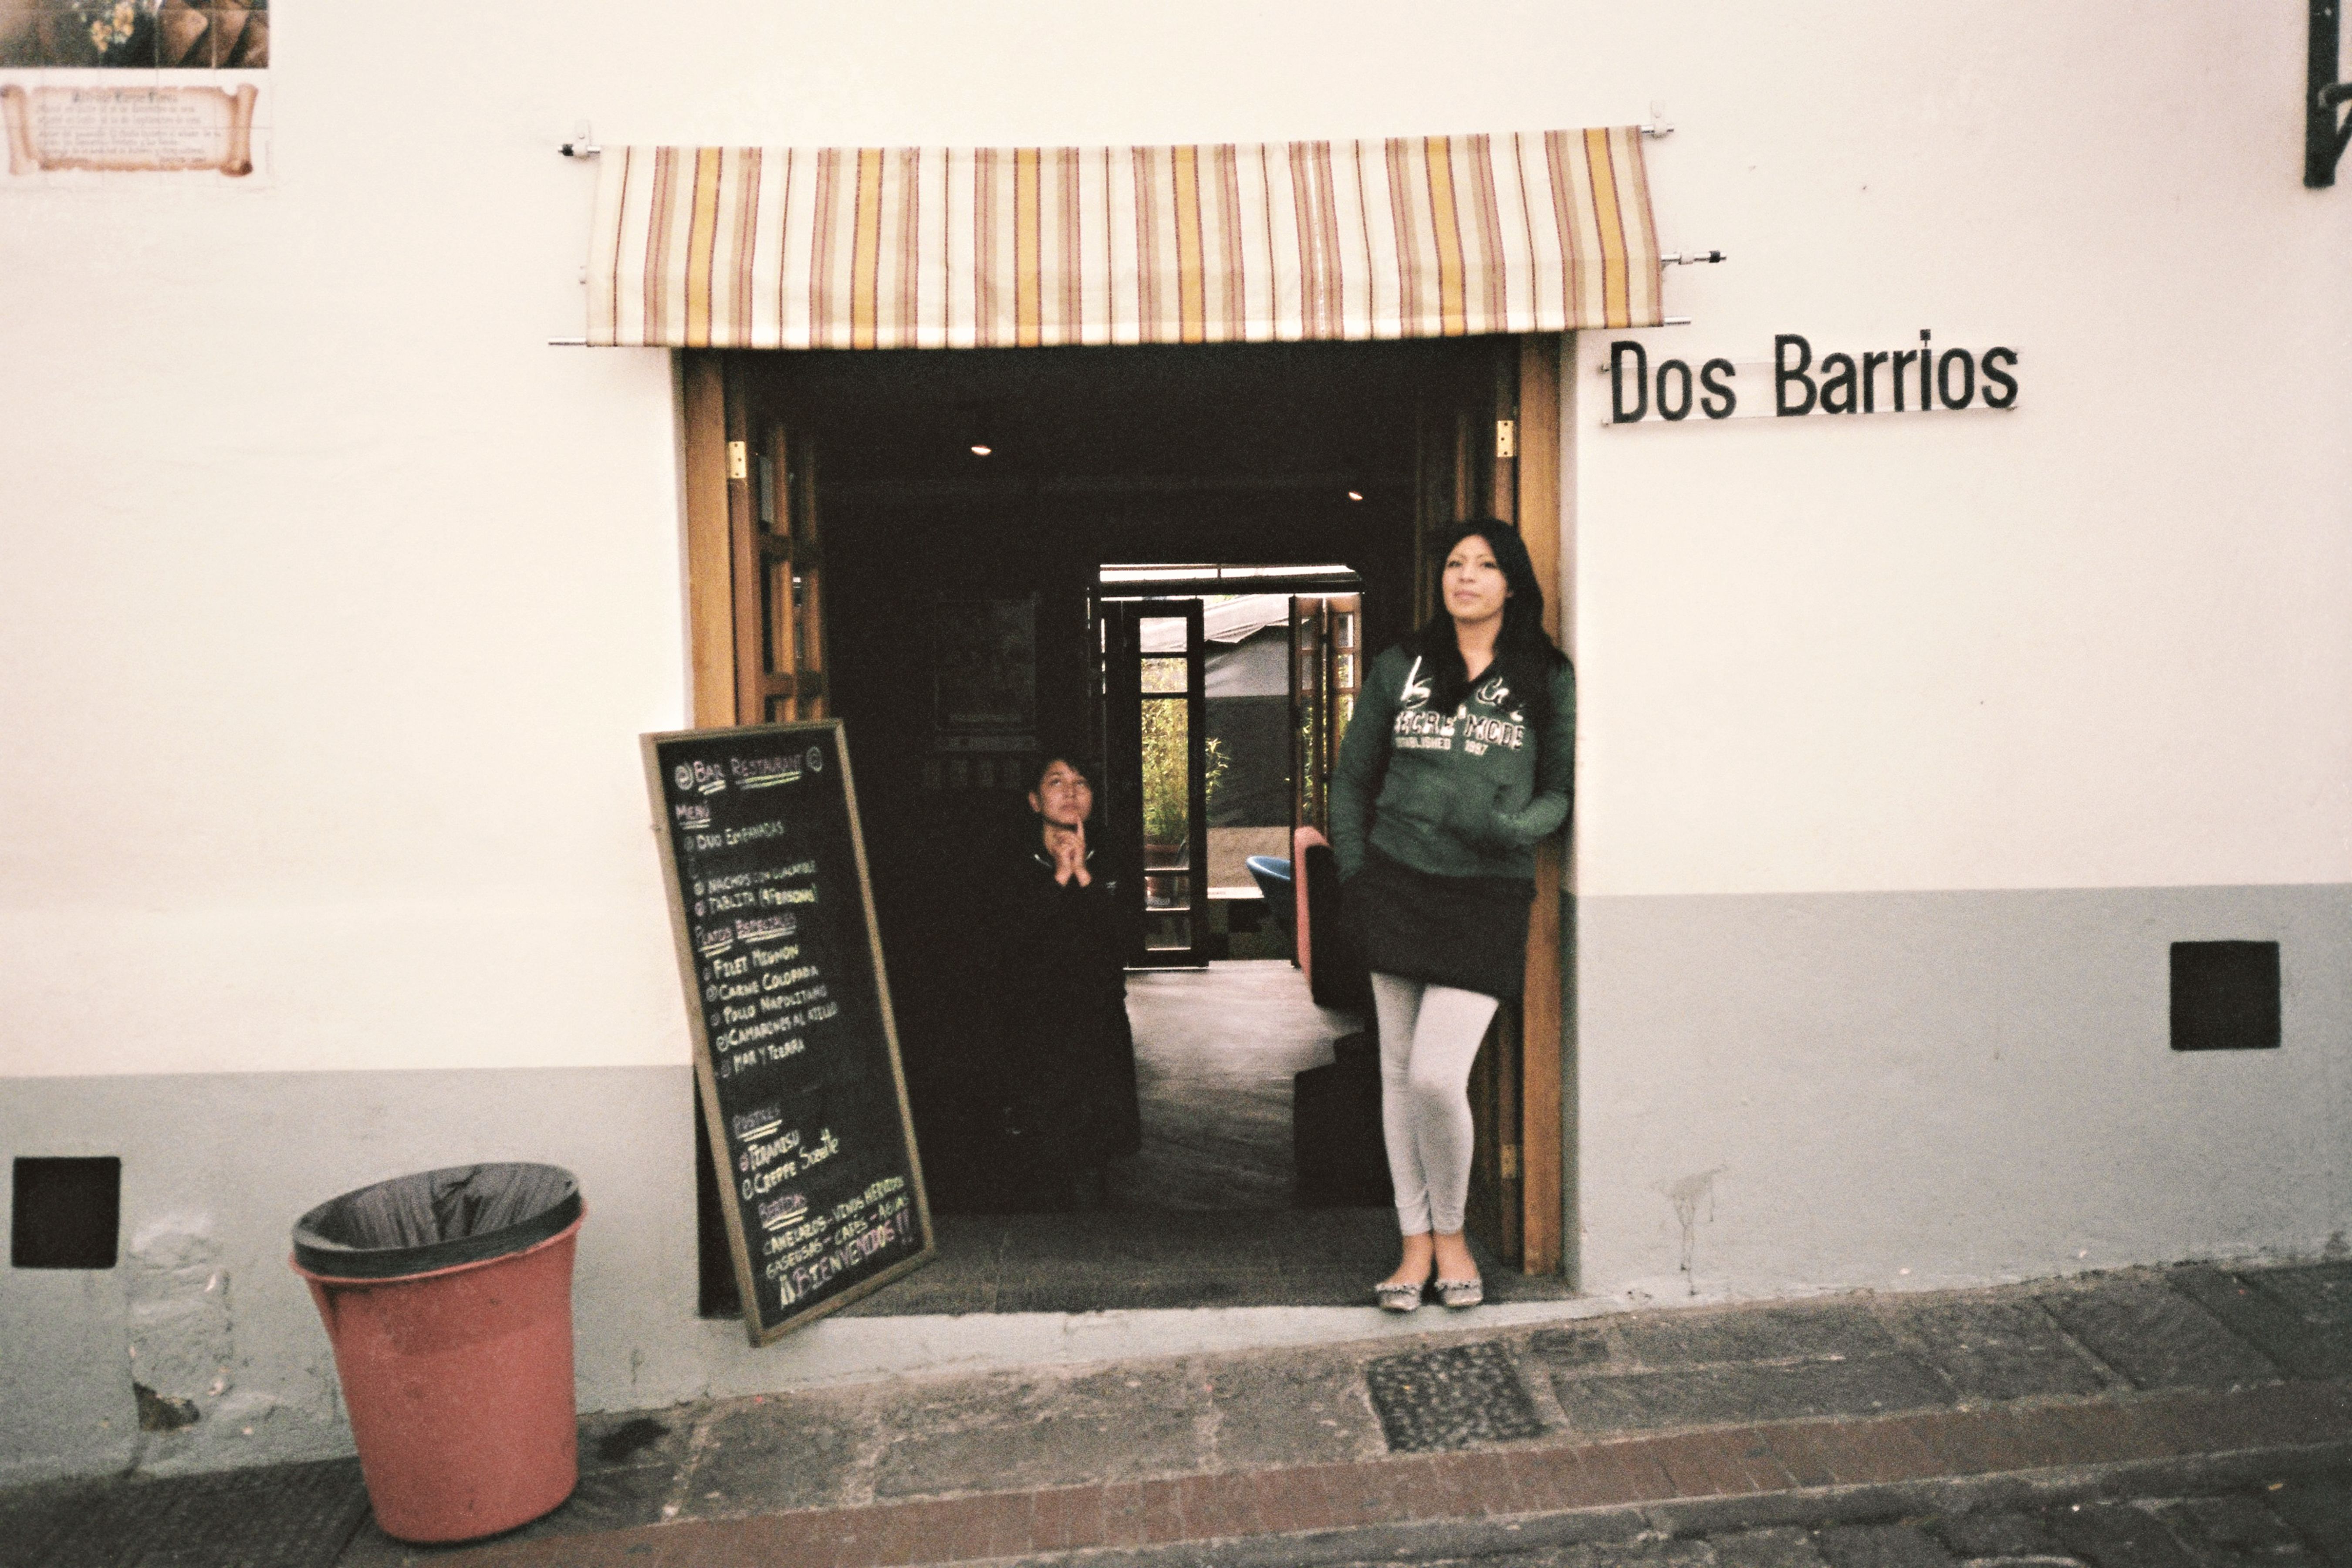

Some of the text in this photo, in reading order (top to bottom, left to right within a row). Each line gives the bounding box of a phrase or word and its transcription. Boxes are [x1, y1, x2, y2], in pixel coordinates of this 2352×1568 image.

[1611, 329, 2018, 424] Dos Barrios
[693, 760, 726, 783] BAR
[713, 956, 747, 979] FILET
[719, 981, 760, 1001] CARNE
[723, 1004, 756, 1024] POLLO
[758, 1047, 767, 1066] Y
